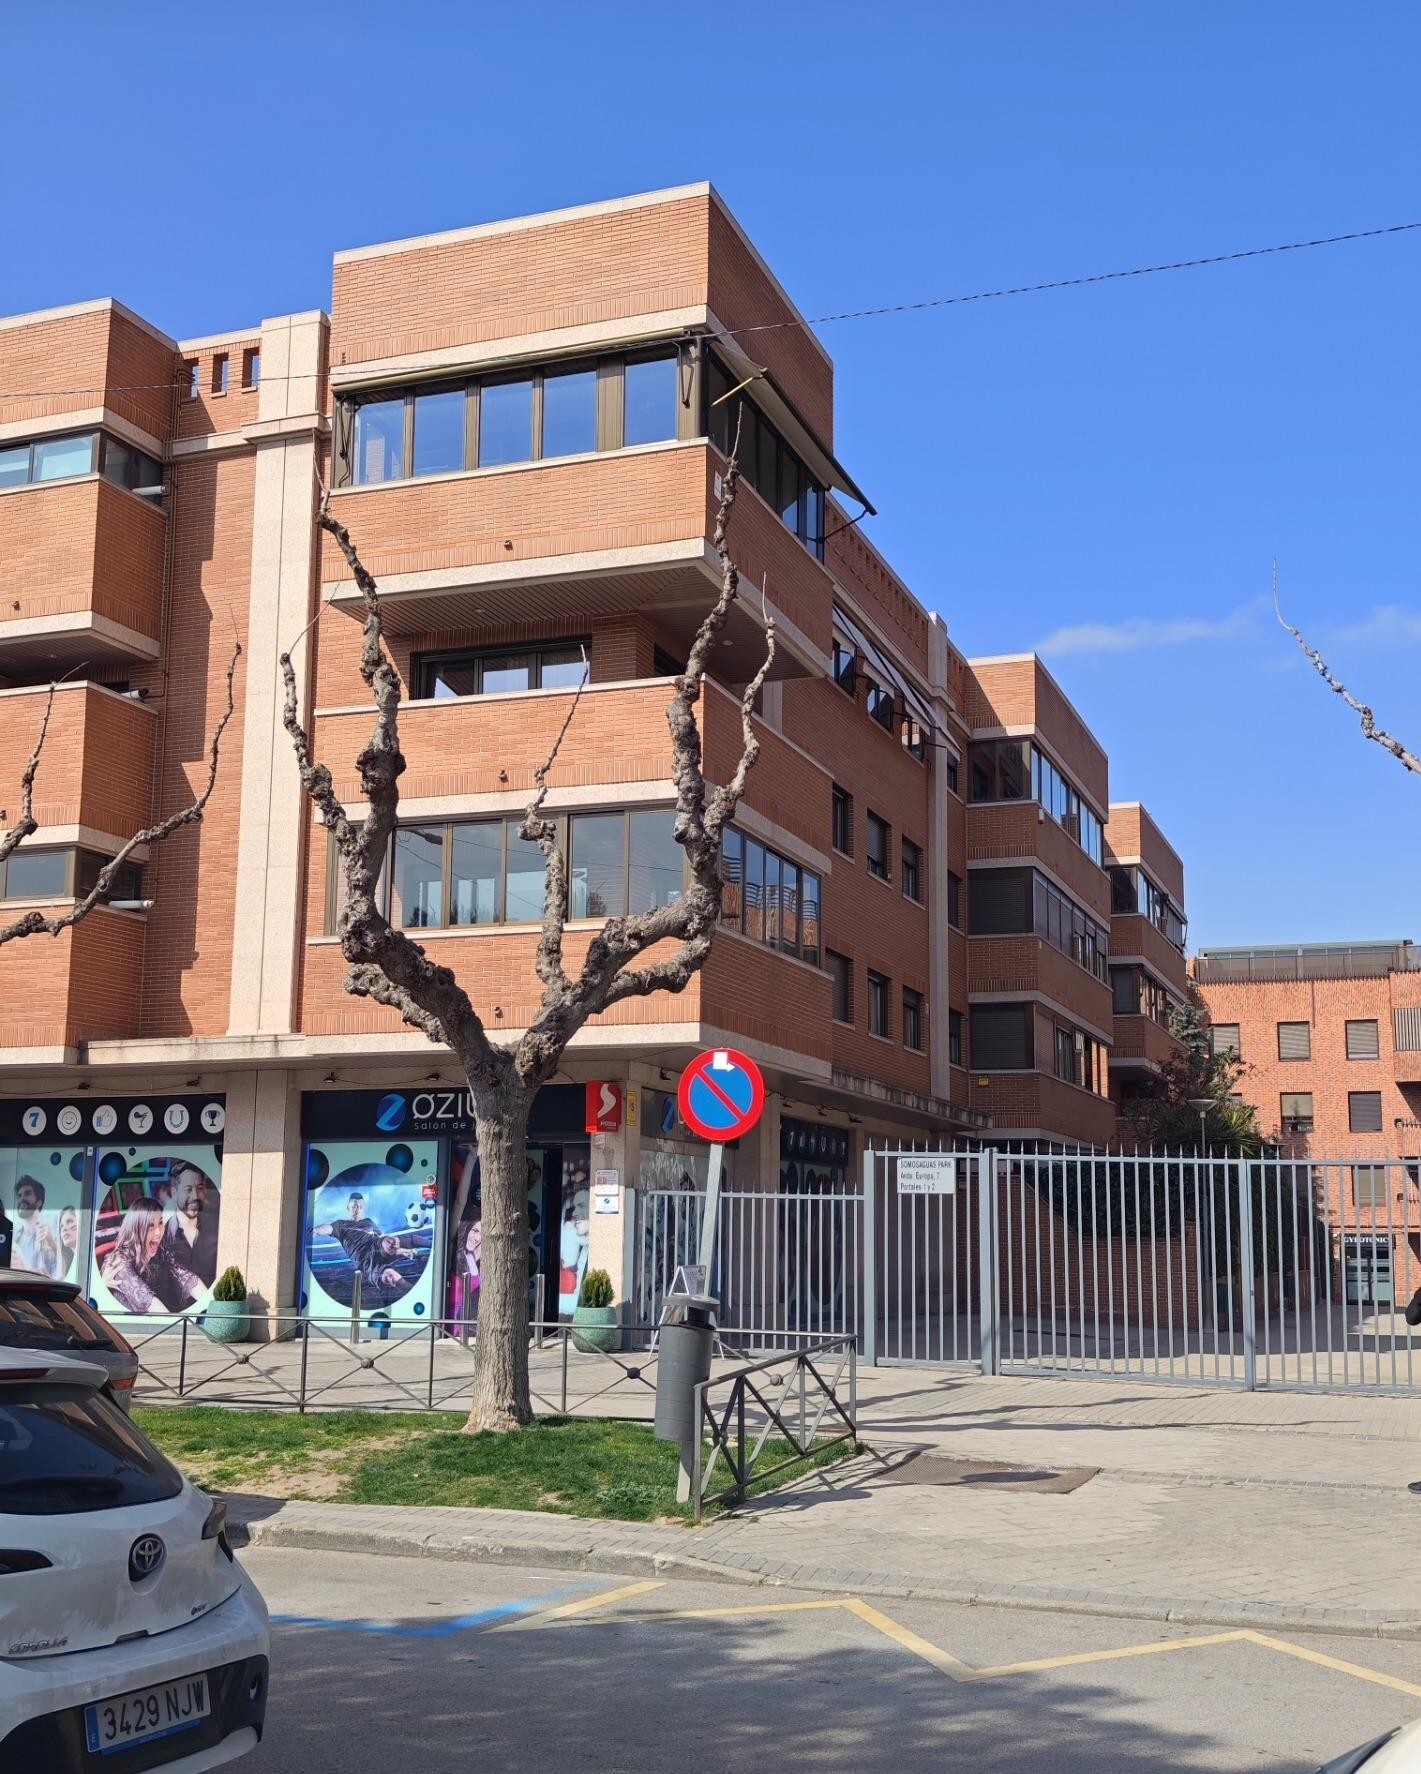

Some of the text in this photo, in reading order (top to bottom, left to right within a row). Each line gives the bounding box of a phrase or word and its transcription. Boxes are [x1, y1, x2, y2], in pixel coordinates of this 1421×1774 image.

[900, 1182, 922, 1191] Portales
[103, 1680, 204, 1741] 3429 NJW
